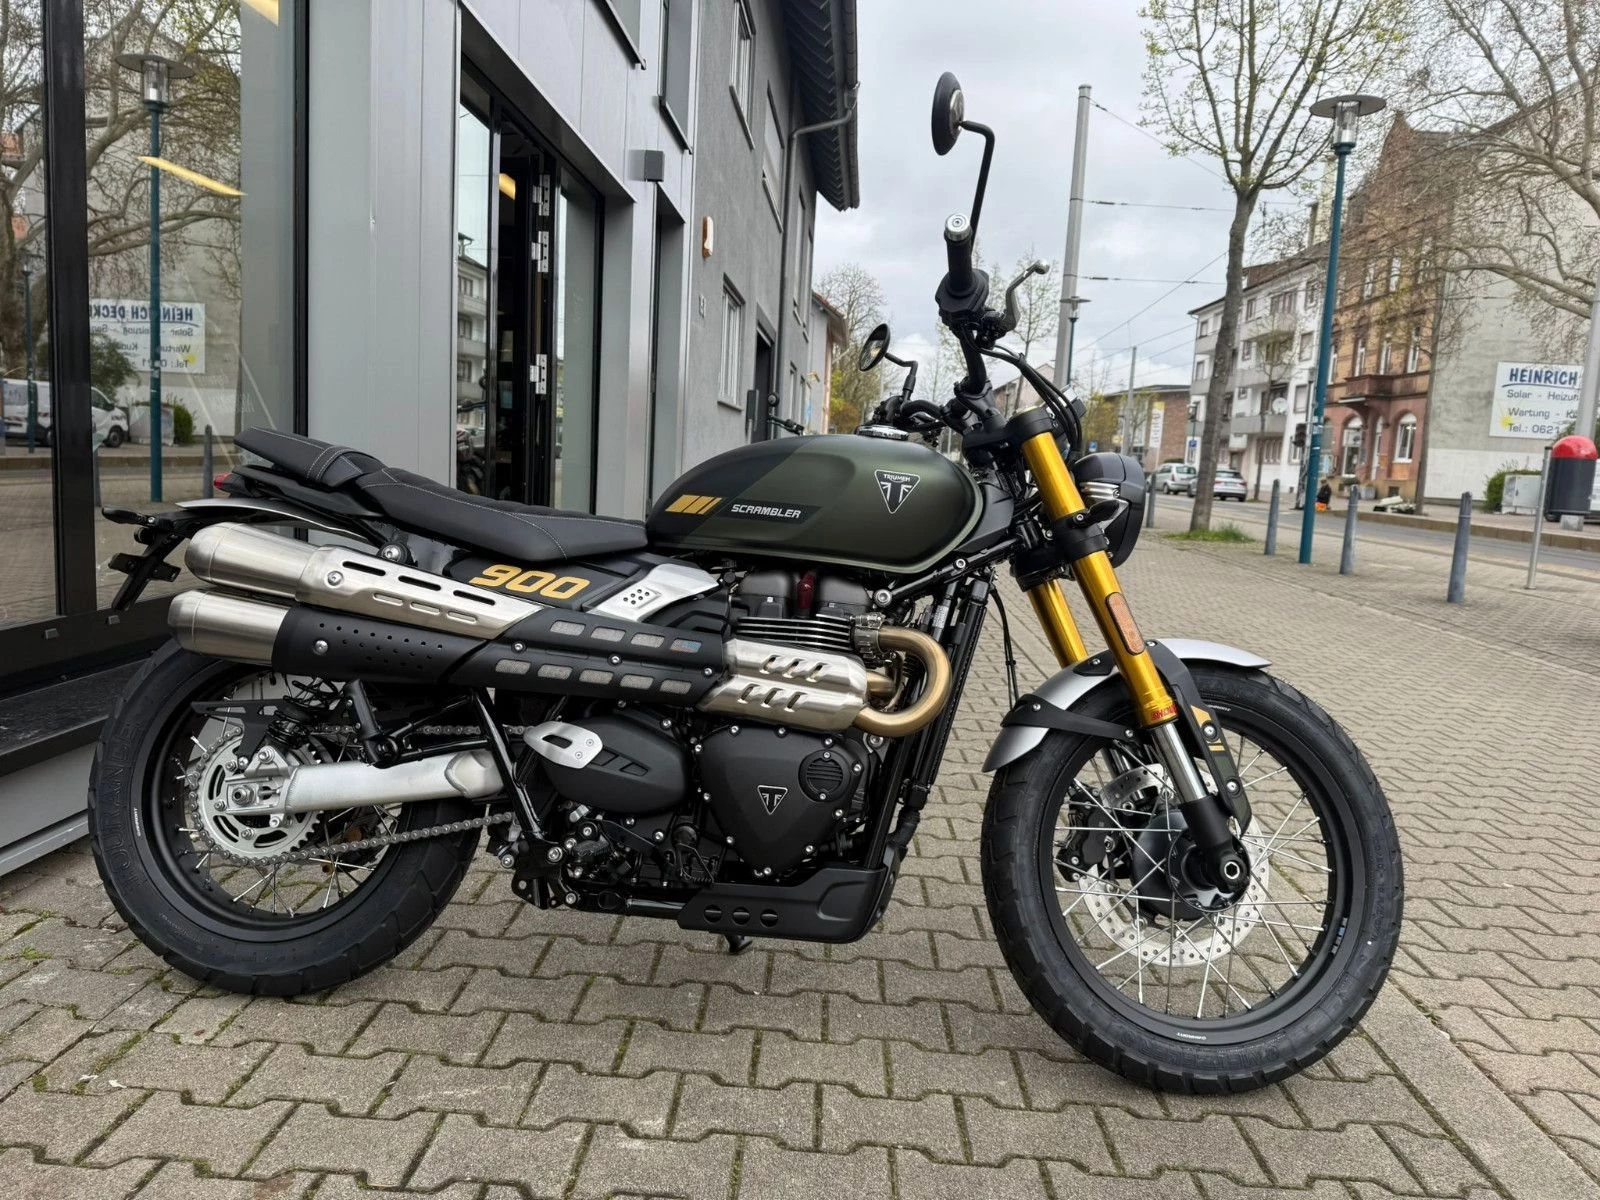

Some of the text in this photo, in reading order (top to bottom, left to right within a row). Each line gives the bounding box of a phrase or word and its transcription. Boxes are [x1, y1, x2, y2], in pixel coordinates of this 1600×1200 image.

[1509, 368, 1577, 385] HEINRICH
[1507, 389, 1532, 399] Solar
[1509, 407, 1550, 420] Wartung
[1508, 423, 1560, 434] Tel.: 0621
[883, 474, 911, 482] TRIUMPH
[731, 504, 802, 519] SCRAMBLER
[469, 564, 591, 599] 900
